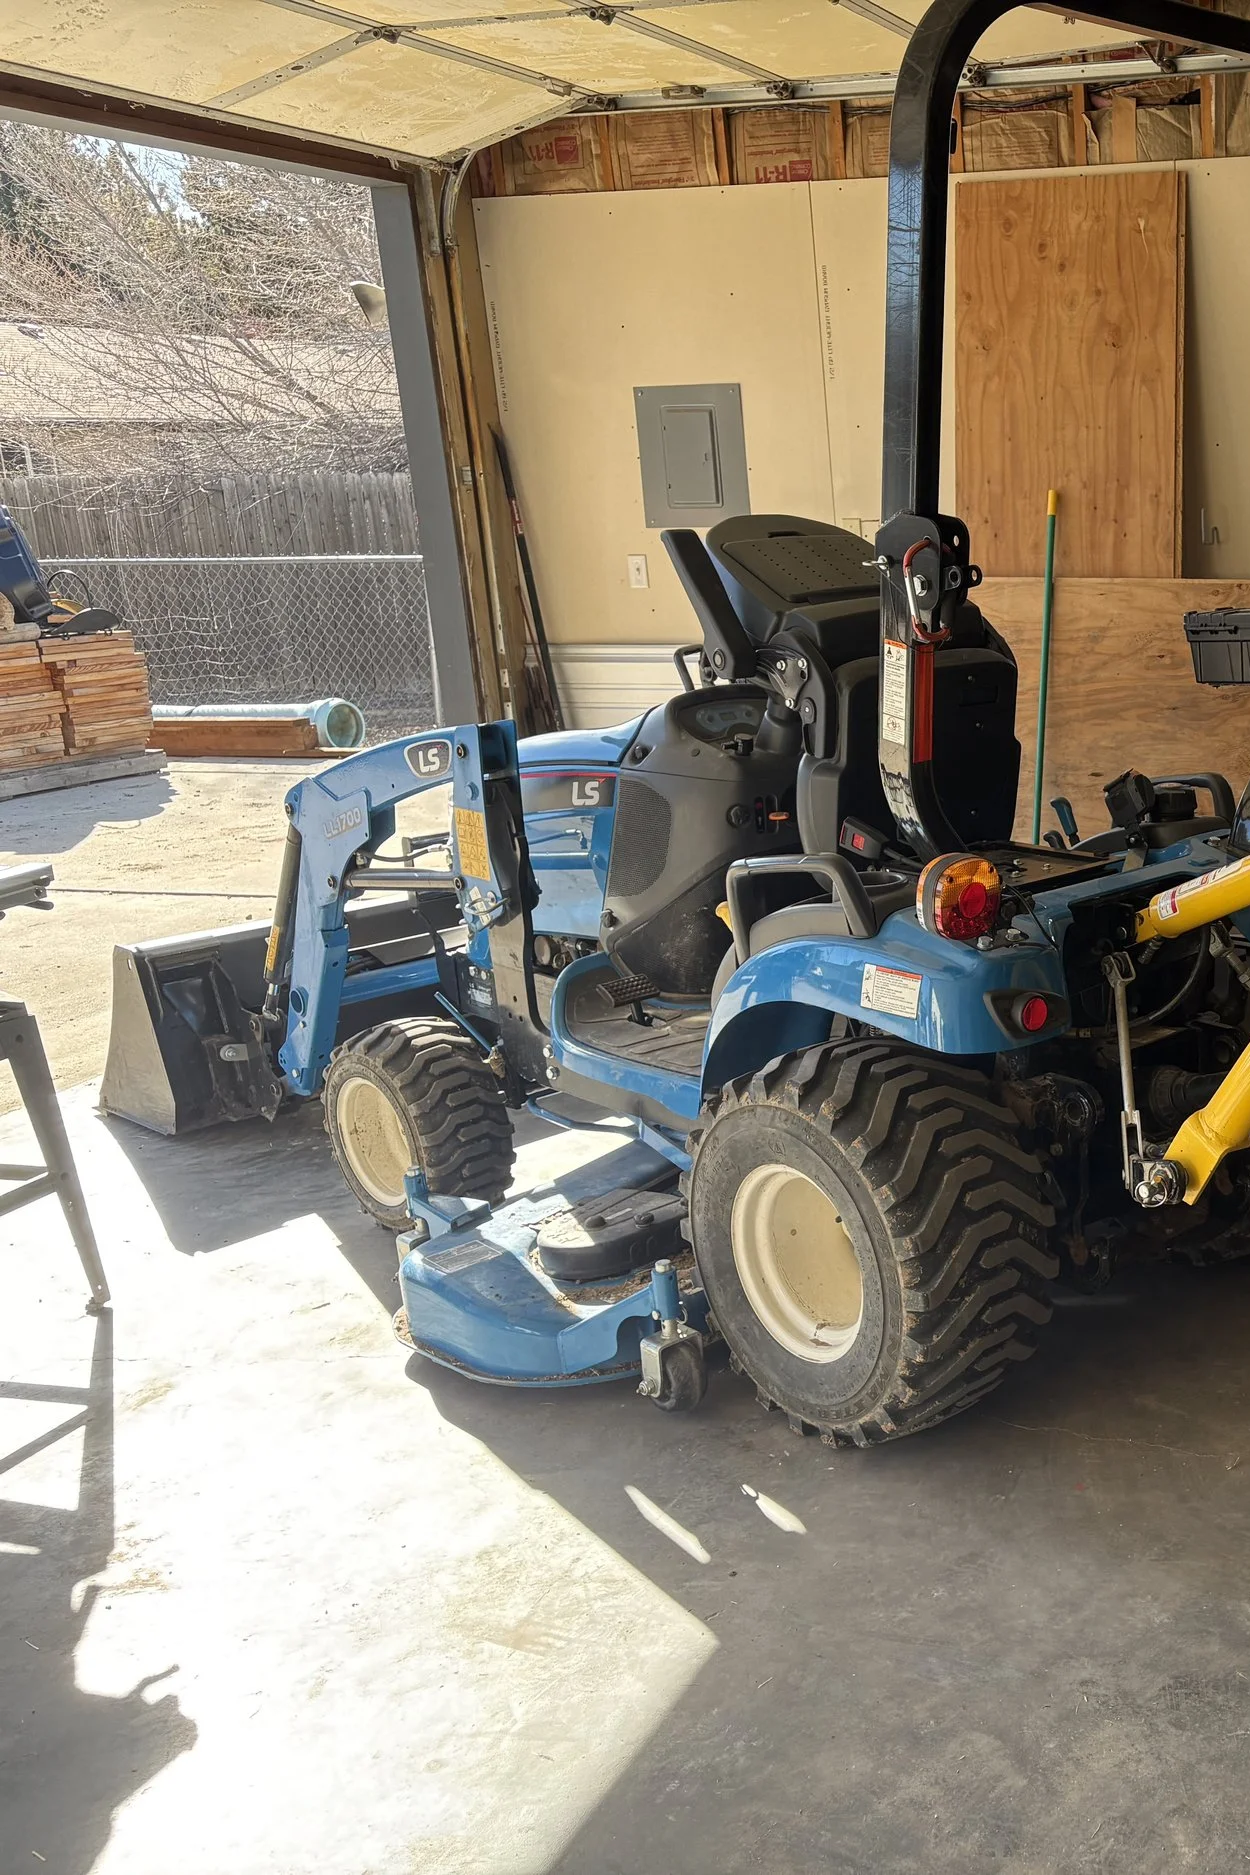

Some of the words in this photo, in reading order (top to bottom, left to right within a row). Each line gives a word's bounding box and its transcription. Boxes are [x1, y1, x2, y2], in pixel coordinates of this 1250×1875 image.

[755, 165, 788, 184] R-11
[821, 265, 829, 286] BOARD
[419, 748, 440, 773] LS
[572, 781, 600, 806] LS
[323, 807, 361, 837] LL1700
